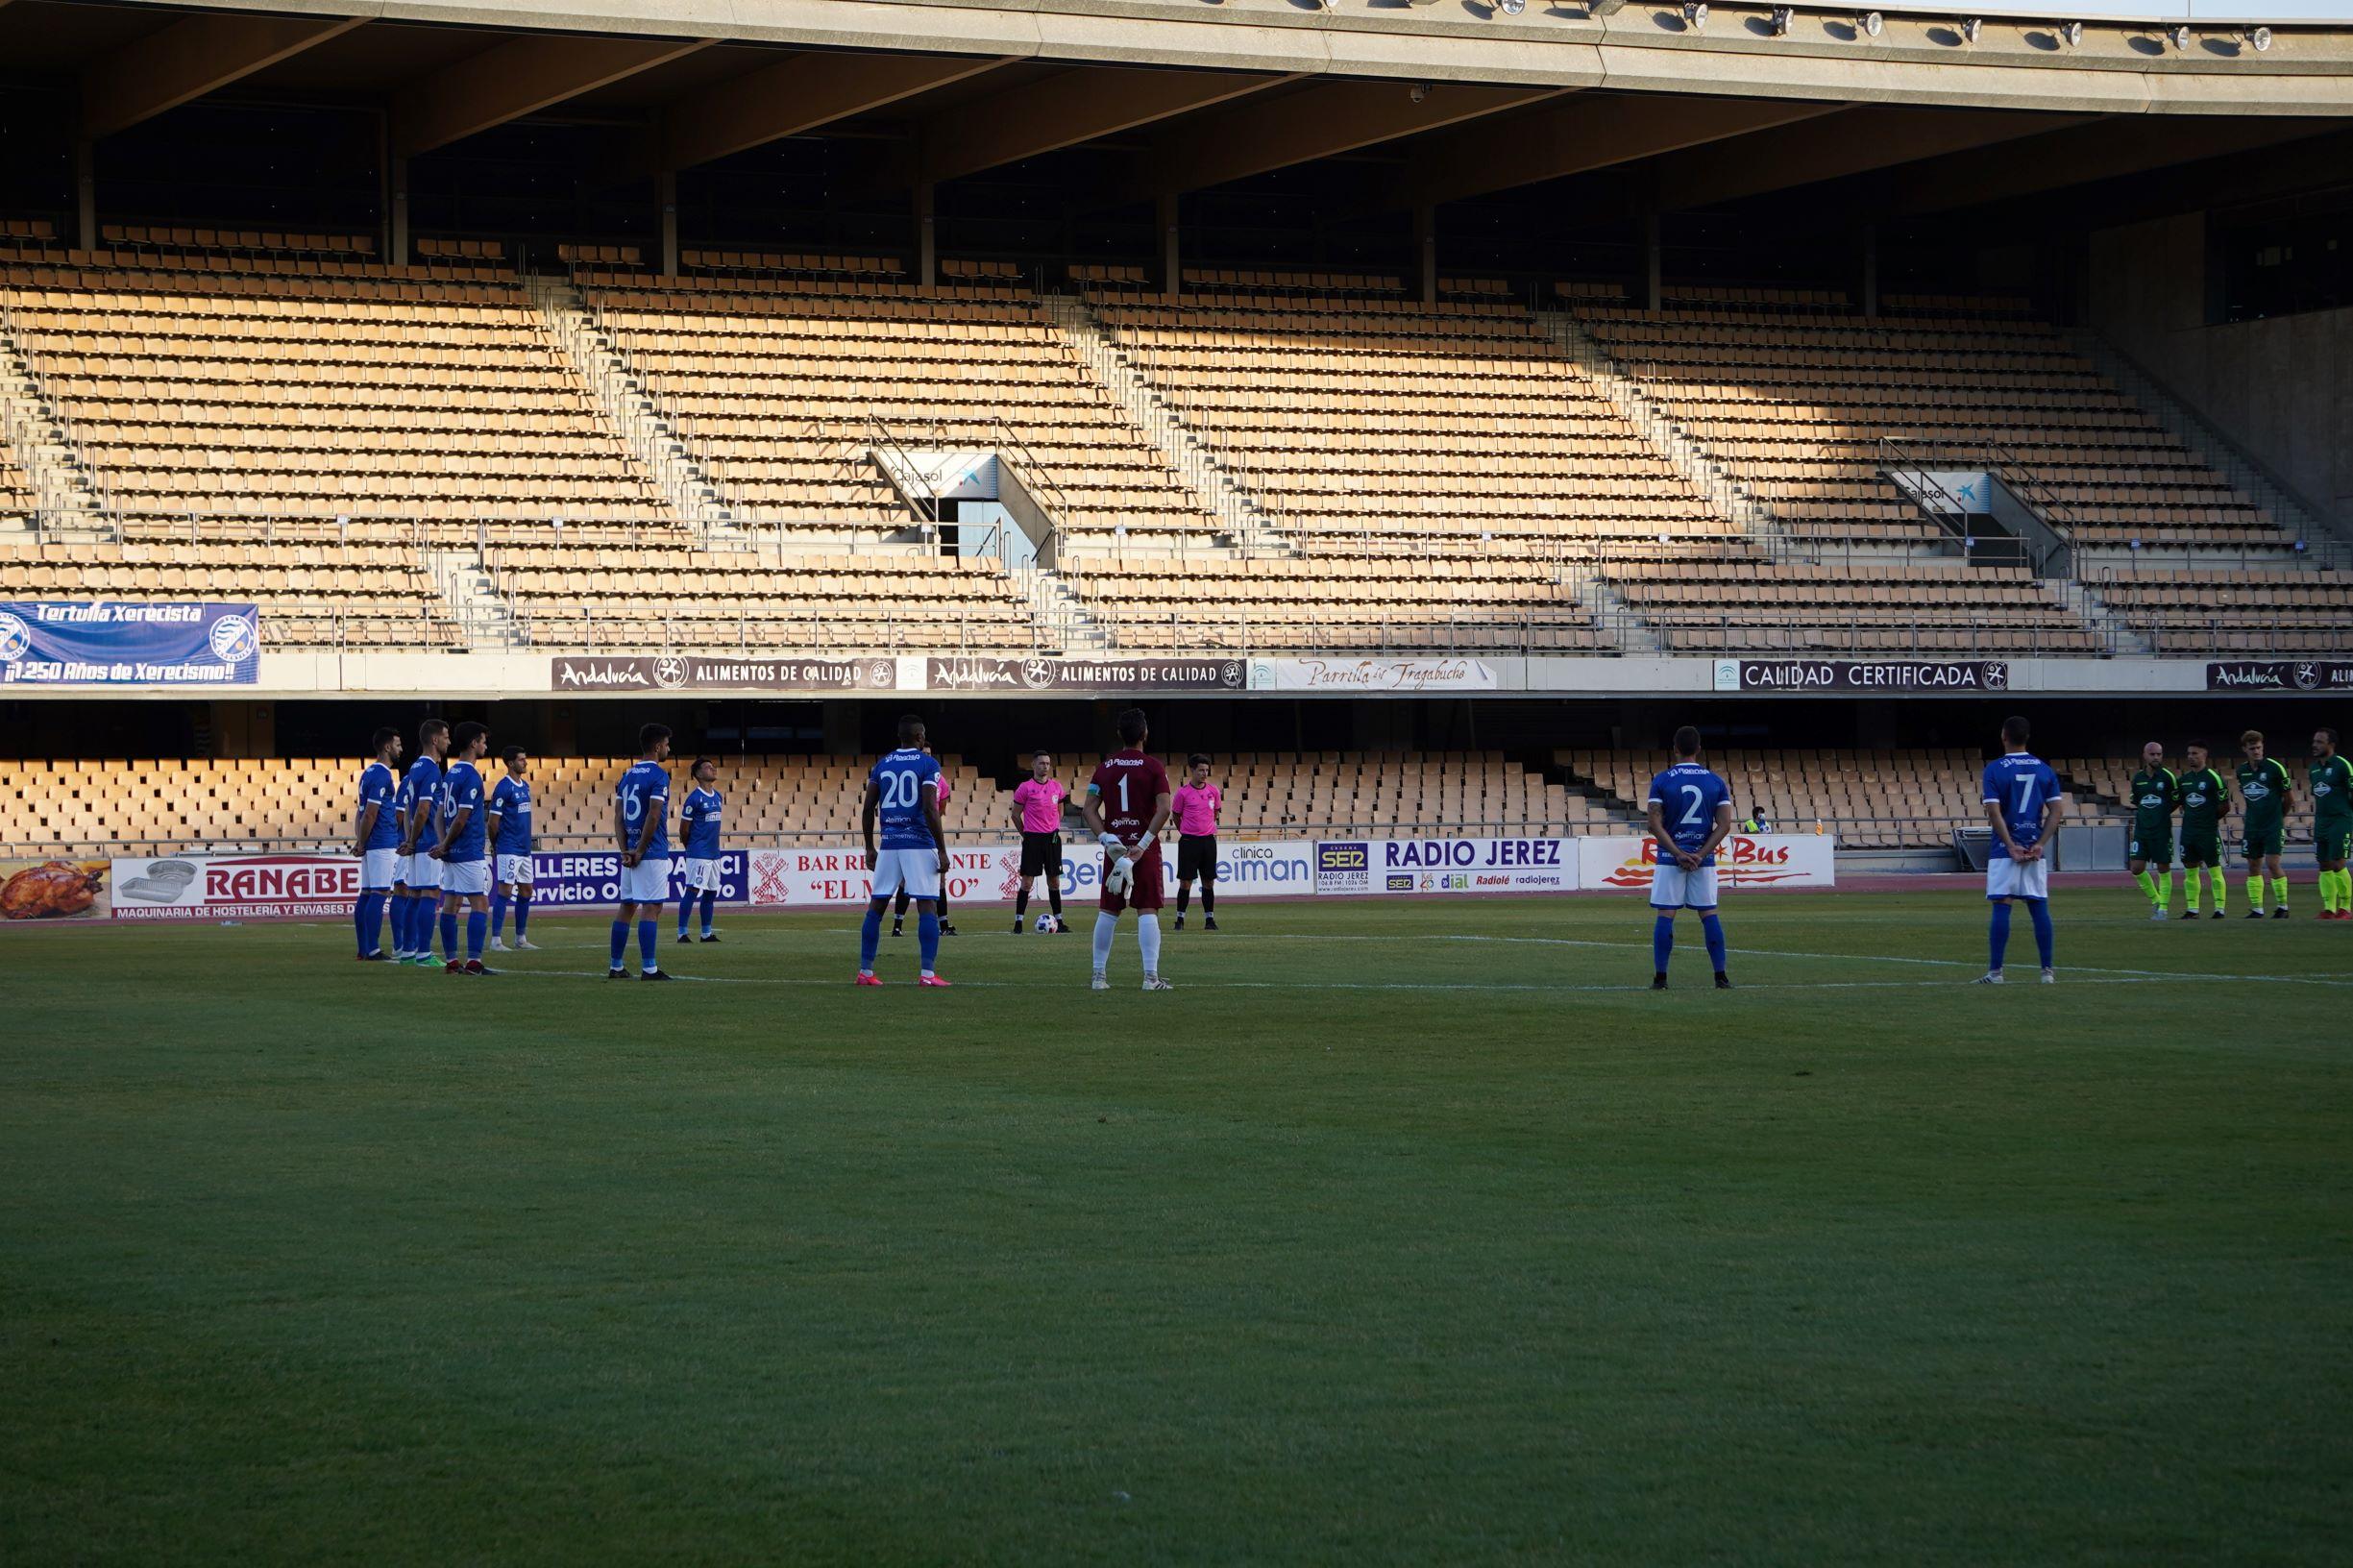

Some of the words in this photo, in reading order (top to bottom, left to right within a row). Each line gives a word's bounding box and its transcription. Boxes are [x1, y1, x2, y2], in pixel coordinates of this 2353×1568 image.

[112, 605, 201, 623] Xerecista
[64, 662, 109, 680] Años
[111, 662, 133, 680] de
[135, 663, 234, 681] Xerecismo!!
[560, 662, 650, 686] Andalucía
[696, 665, 774, 682] ALIMENTOS
[780, 666, 797, 682] DE
[801, 665, 862, 683] CALIDAD
[935, 662, 1017, 685] Andalucía
[1061, 666, 1135, 682] ALIMENTOS
[1140, 667, 1156, 682] DE
[1162, 667, 1216, 682] CALIDAD
[1299, 658, 1373, 686] Parrilla
[1745, 665, 1833, 686] CALIDAD
[1848, 665, 1976, 685] CERTIFICADA
[2216, 665, 2285, 685] Andalucía
[880, 770, 919, 809] 20
[1117, 772, 1129, 812] 1
[2015, 773, 2037, 814] 7
[622, 783, 642, 821] 15
[1679, 784, 1703, 824] 2
[1322, 850, 1364, 868] SER
[1386, 841, 1476, 867] RADIO
[1485, 840, 1561, 865] JEREZ
[1732, 837, 1789, 865] Bus
[508, 858, 515, 870] 8
[797, 856, 838, 871] BAR
[1214, 859, 1309, 883] eiman
[1317, 871, 1344, 880] RADIO
[1347, 871, 1368, 880] JEREZ
[1441, 873, 1469, 889] dial
[1476, 875, 1510, 885] Radiolé
[117, 906, 192, 919] MAQUINARIA
[195, 906, 210, 918] DE
[212, 903, 281, 917] HOSTELERÍA
[282, 904, 291, 916] Y
[293, 903, 345, 916] ENVASES
